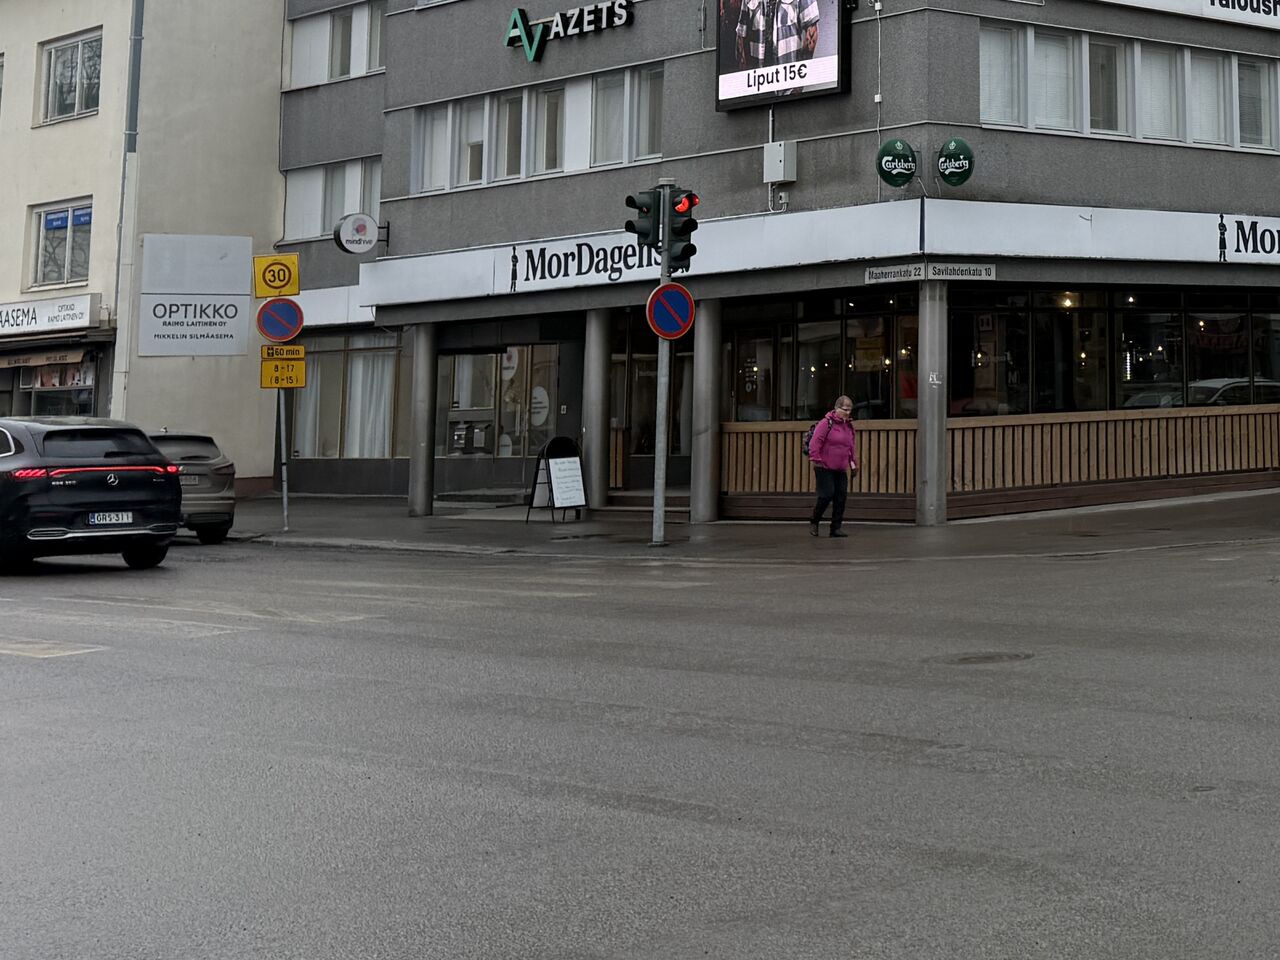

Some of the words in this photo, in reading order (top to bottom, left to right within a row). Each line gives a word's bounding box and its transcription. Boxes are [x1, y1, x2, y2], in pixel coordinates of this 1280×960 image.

[747, 68, 780, 92] Liput
[783, 63, 808, 82] 15€
[882, 156, 916, 174] Carlsberg
[938, 154, 969, 174] Carlsberg
[268, 268, 287, 283] 30
[868, 269, 912, 281] Maaherrankatu
[913, 266, 922, 277] 22
[932, 266, 982, 277] Savilahdenkatu
[984, 267, 992, 277] 10
[153, 303, 238, 319] OPTIKKO
[274, 348, 285, 356] 60
[285, 348, 300, 356] min
